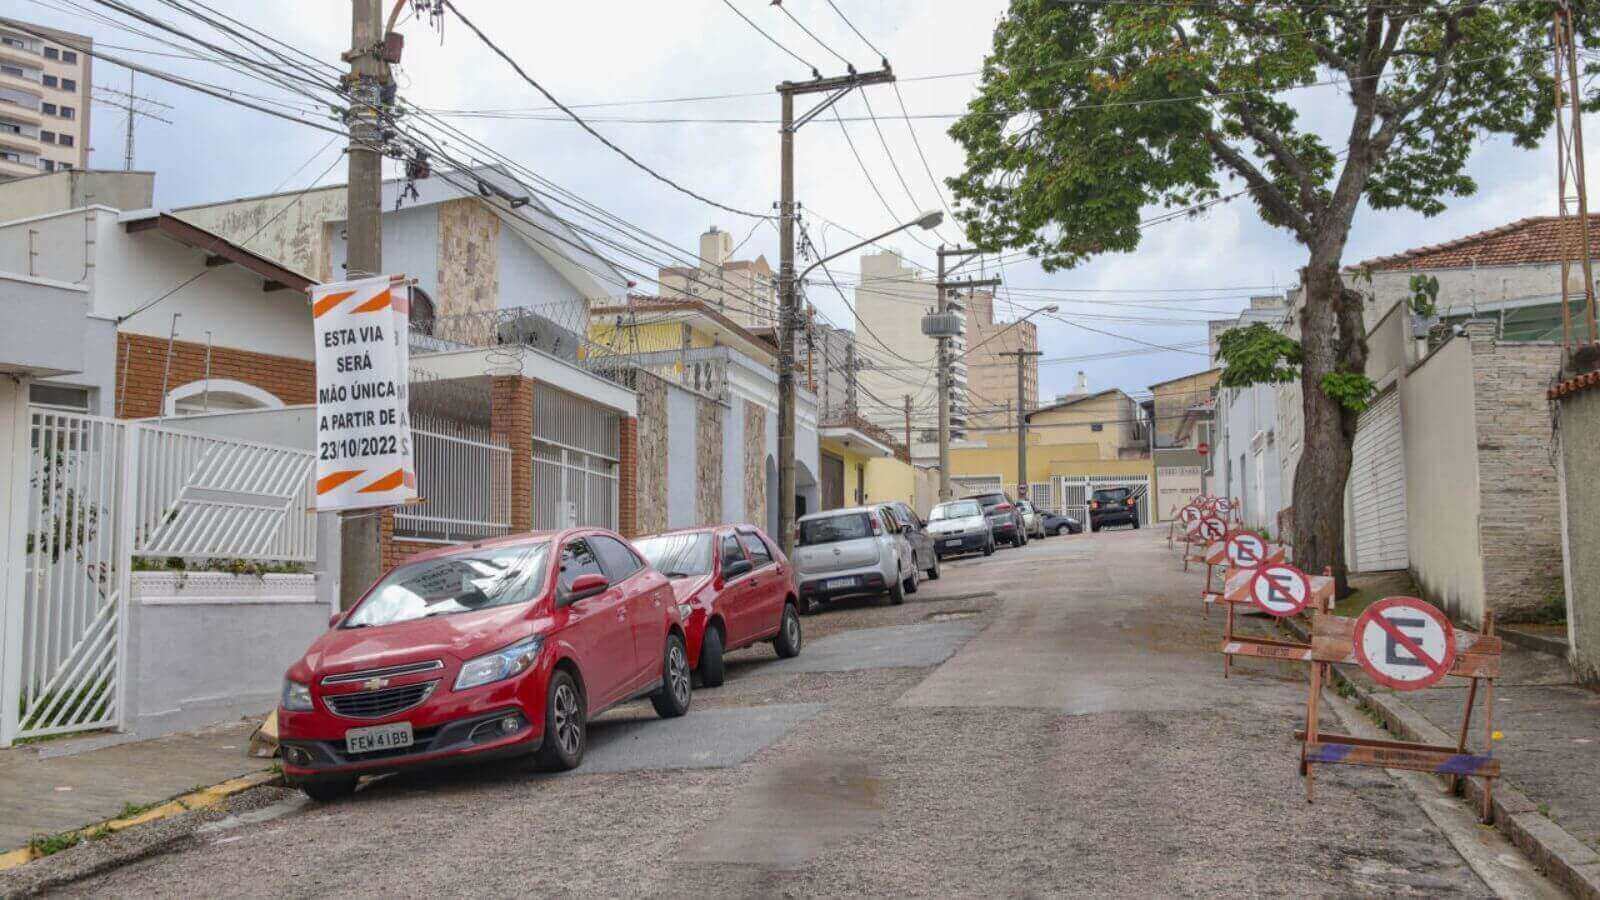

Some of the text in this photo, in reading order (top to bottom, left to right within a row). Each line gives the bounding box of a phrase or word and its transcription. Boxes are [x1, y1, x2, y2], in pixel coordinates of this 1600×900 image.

[324, 325, 384, 348] ESTA VIA
[337, 350, 372, 373] SERÁ
[319, 380, 396, 404] MÃO ÚNICA
[319, 408, 396, 431] A PARTIR DE
[320, 435, 397, 460] 23/10/2022
